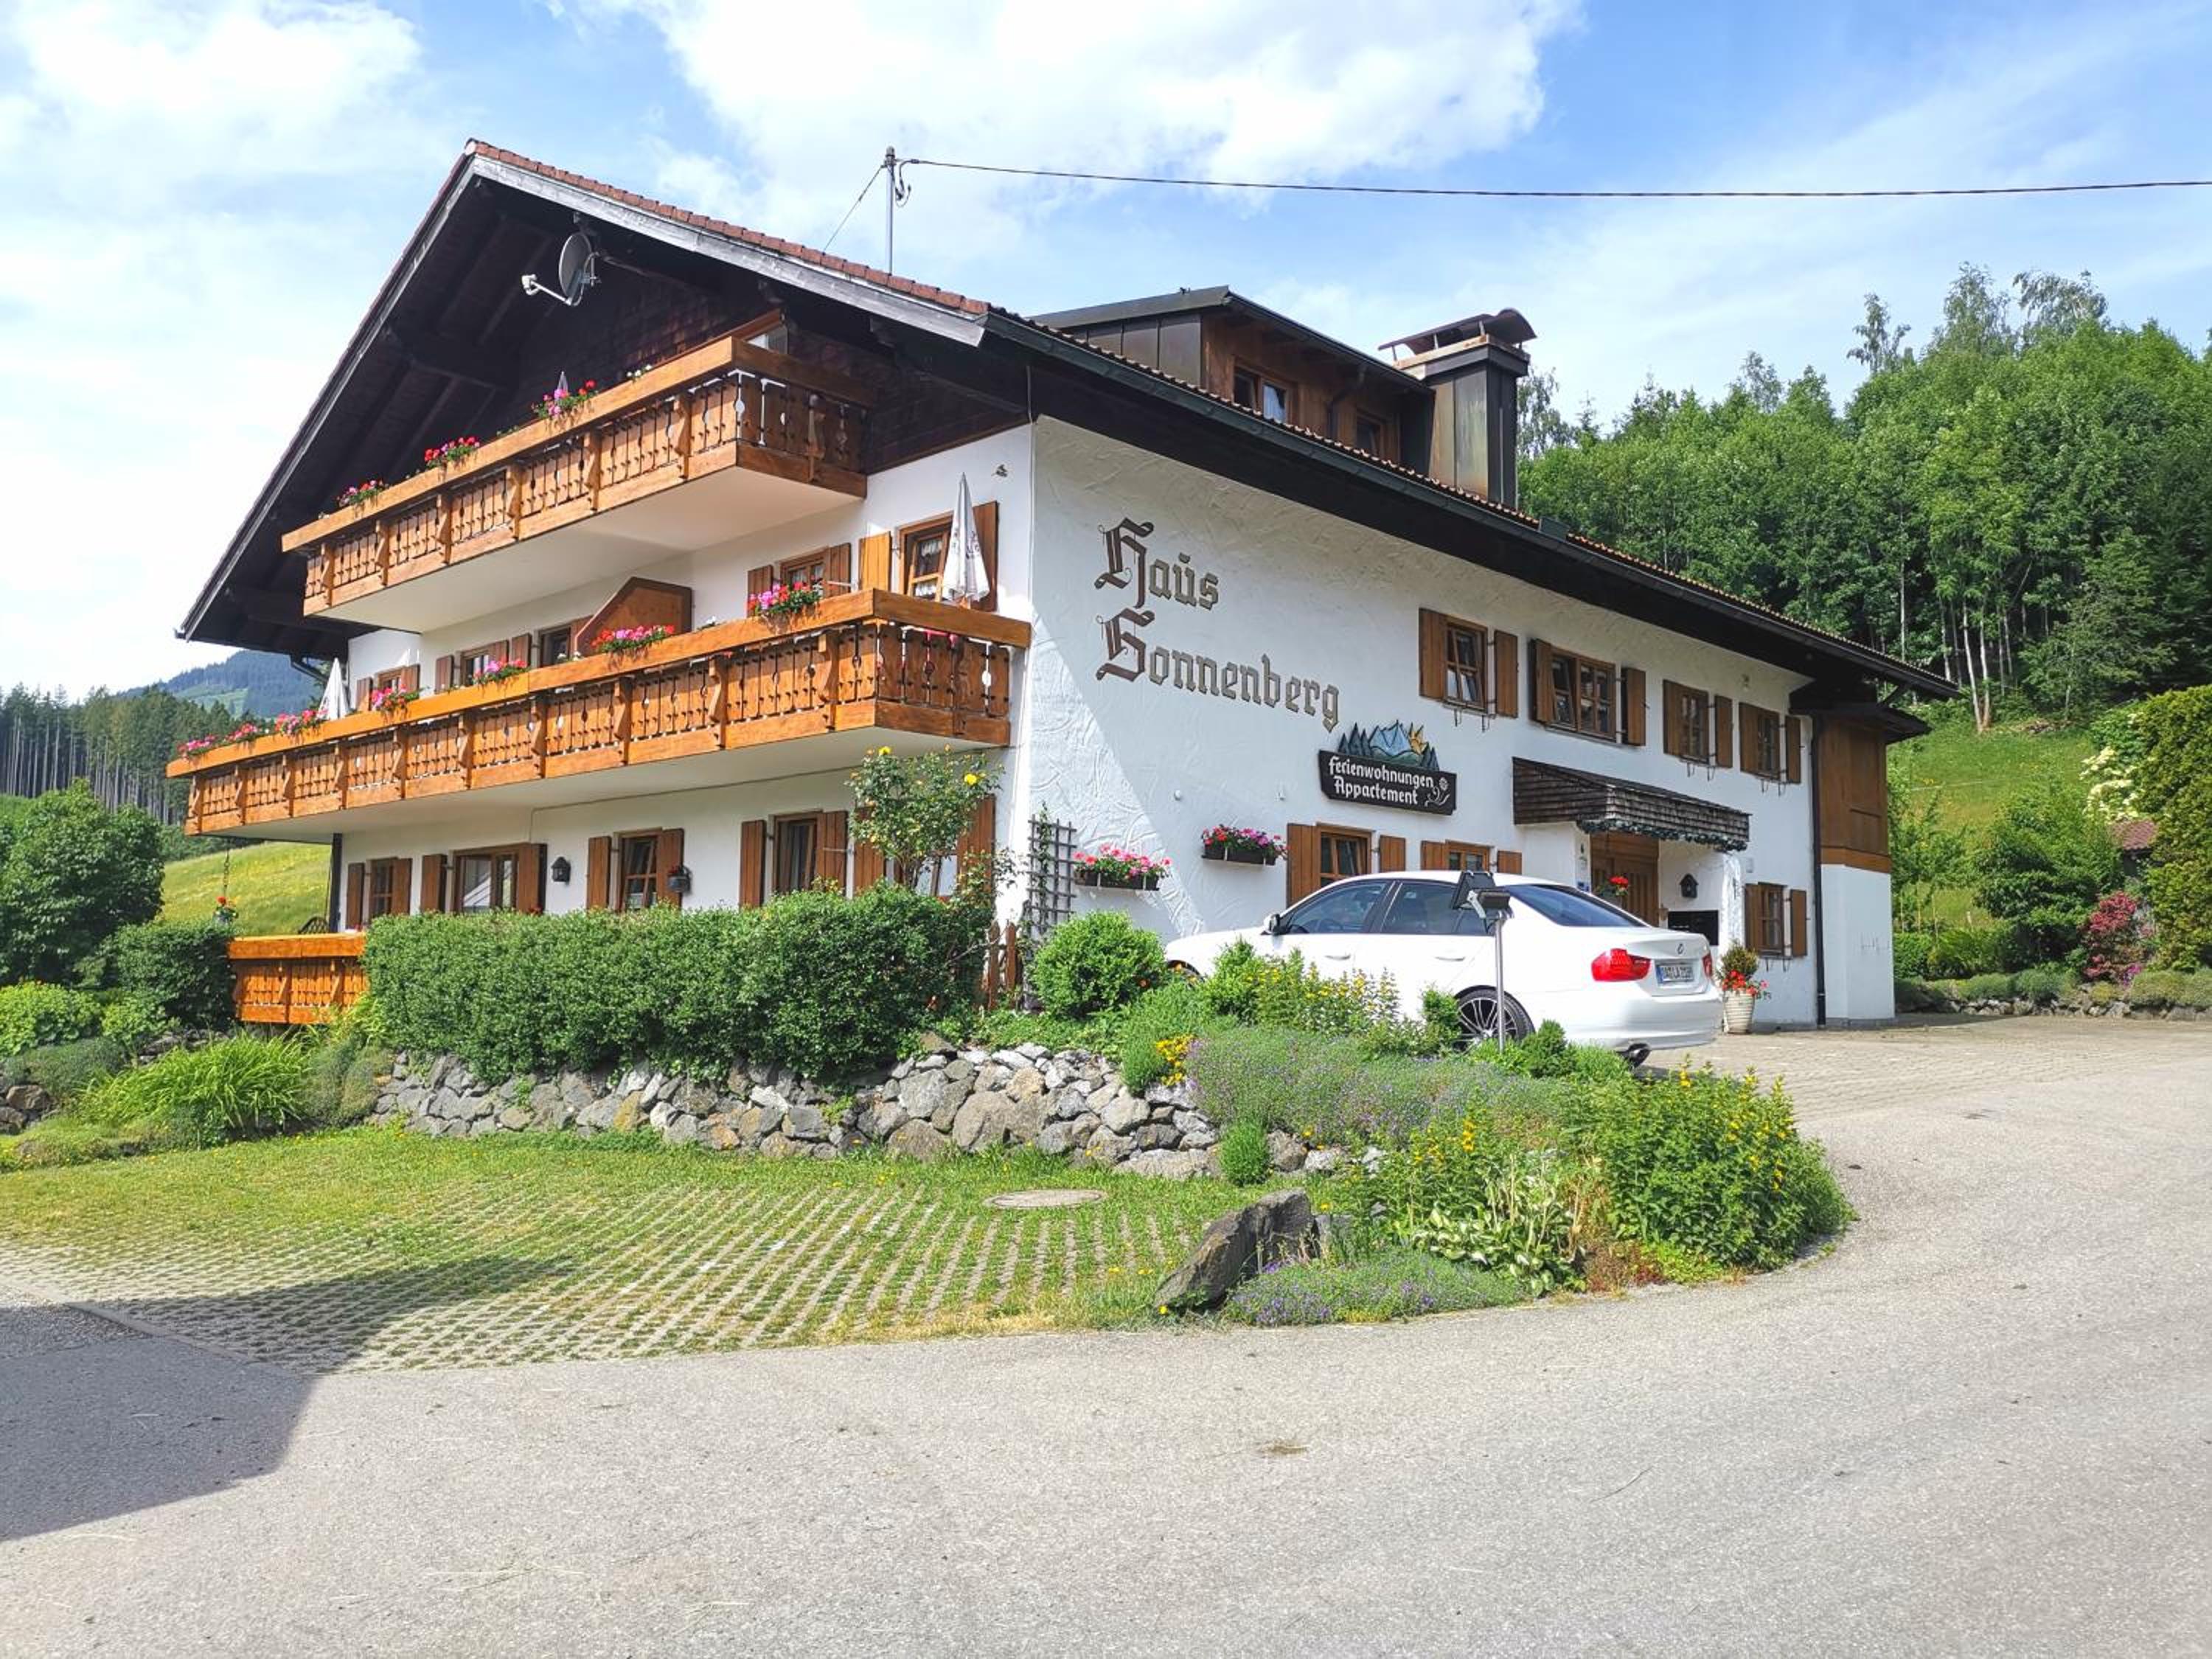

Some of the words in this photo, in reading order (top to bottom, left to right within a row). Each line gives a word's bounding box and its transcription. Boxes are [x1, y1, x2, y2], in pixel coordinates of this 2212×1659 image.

[1095, 607, 1339, 731] Sonnenberg
[1329, 755, 1434, 790] Ferienwohnungen
[1333, 775, 1418, 804] Appartement
